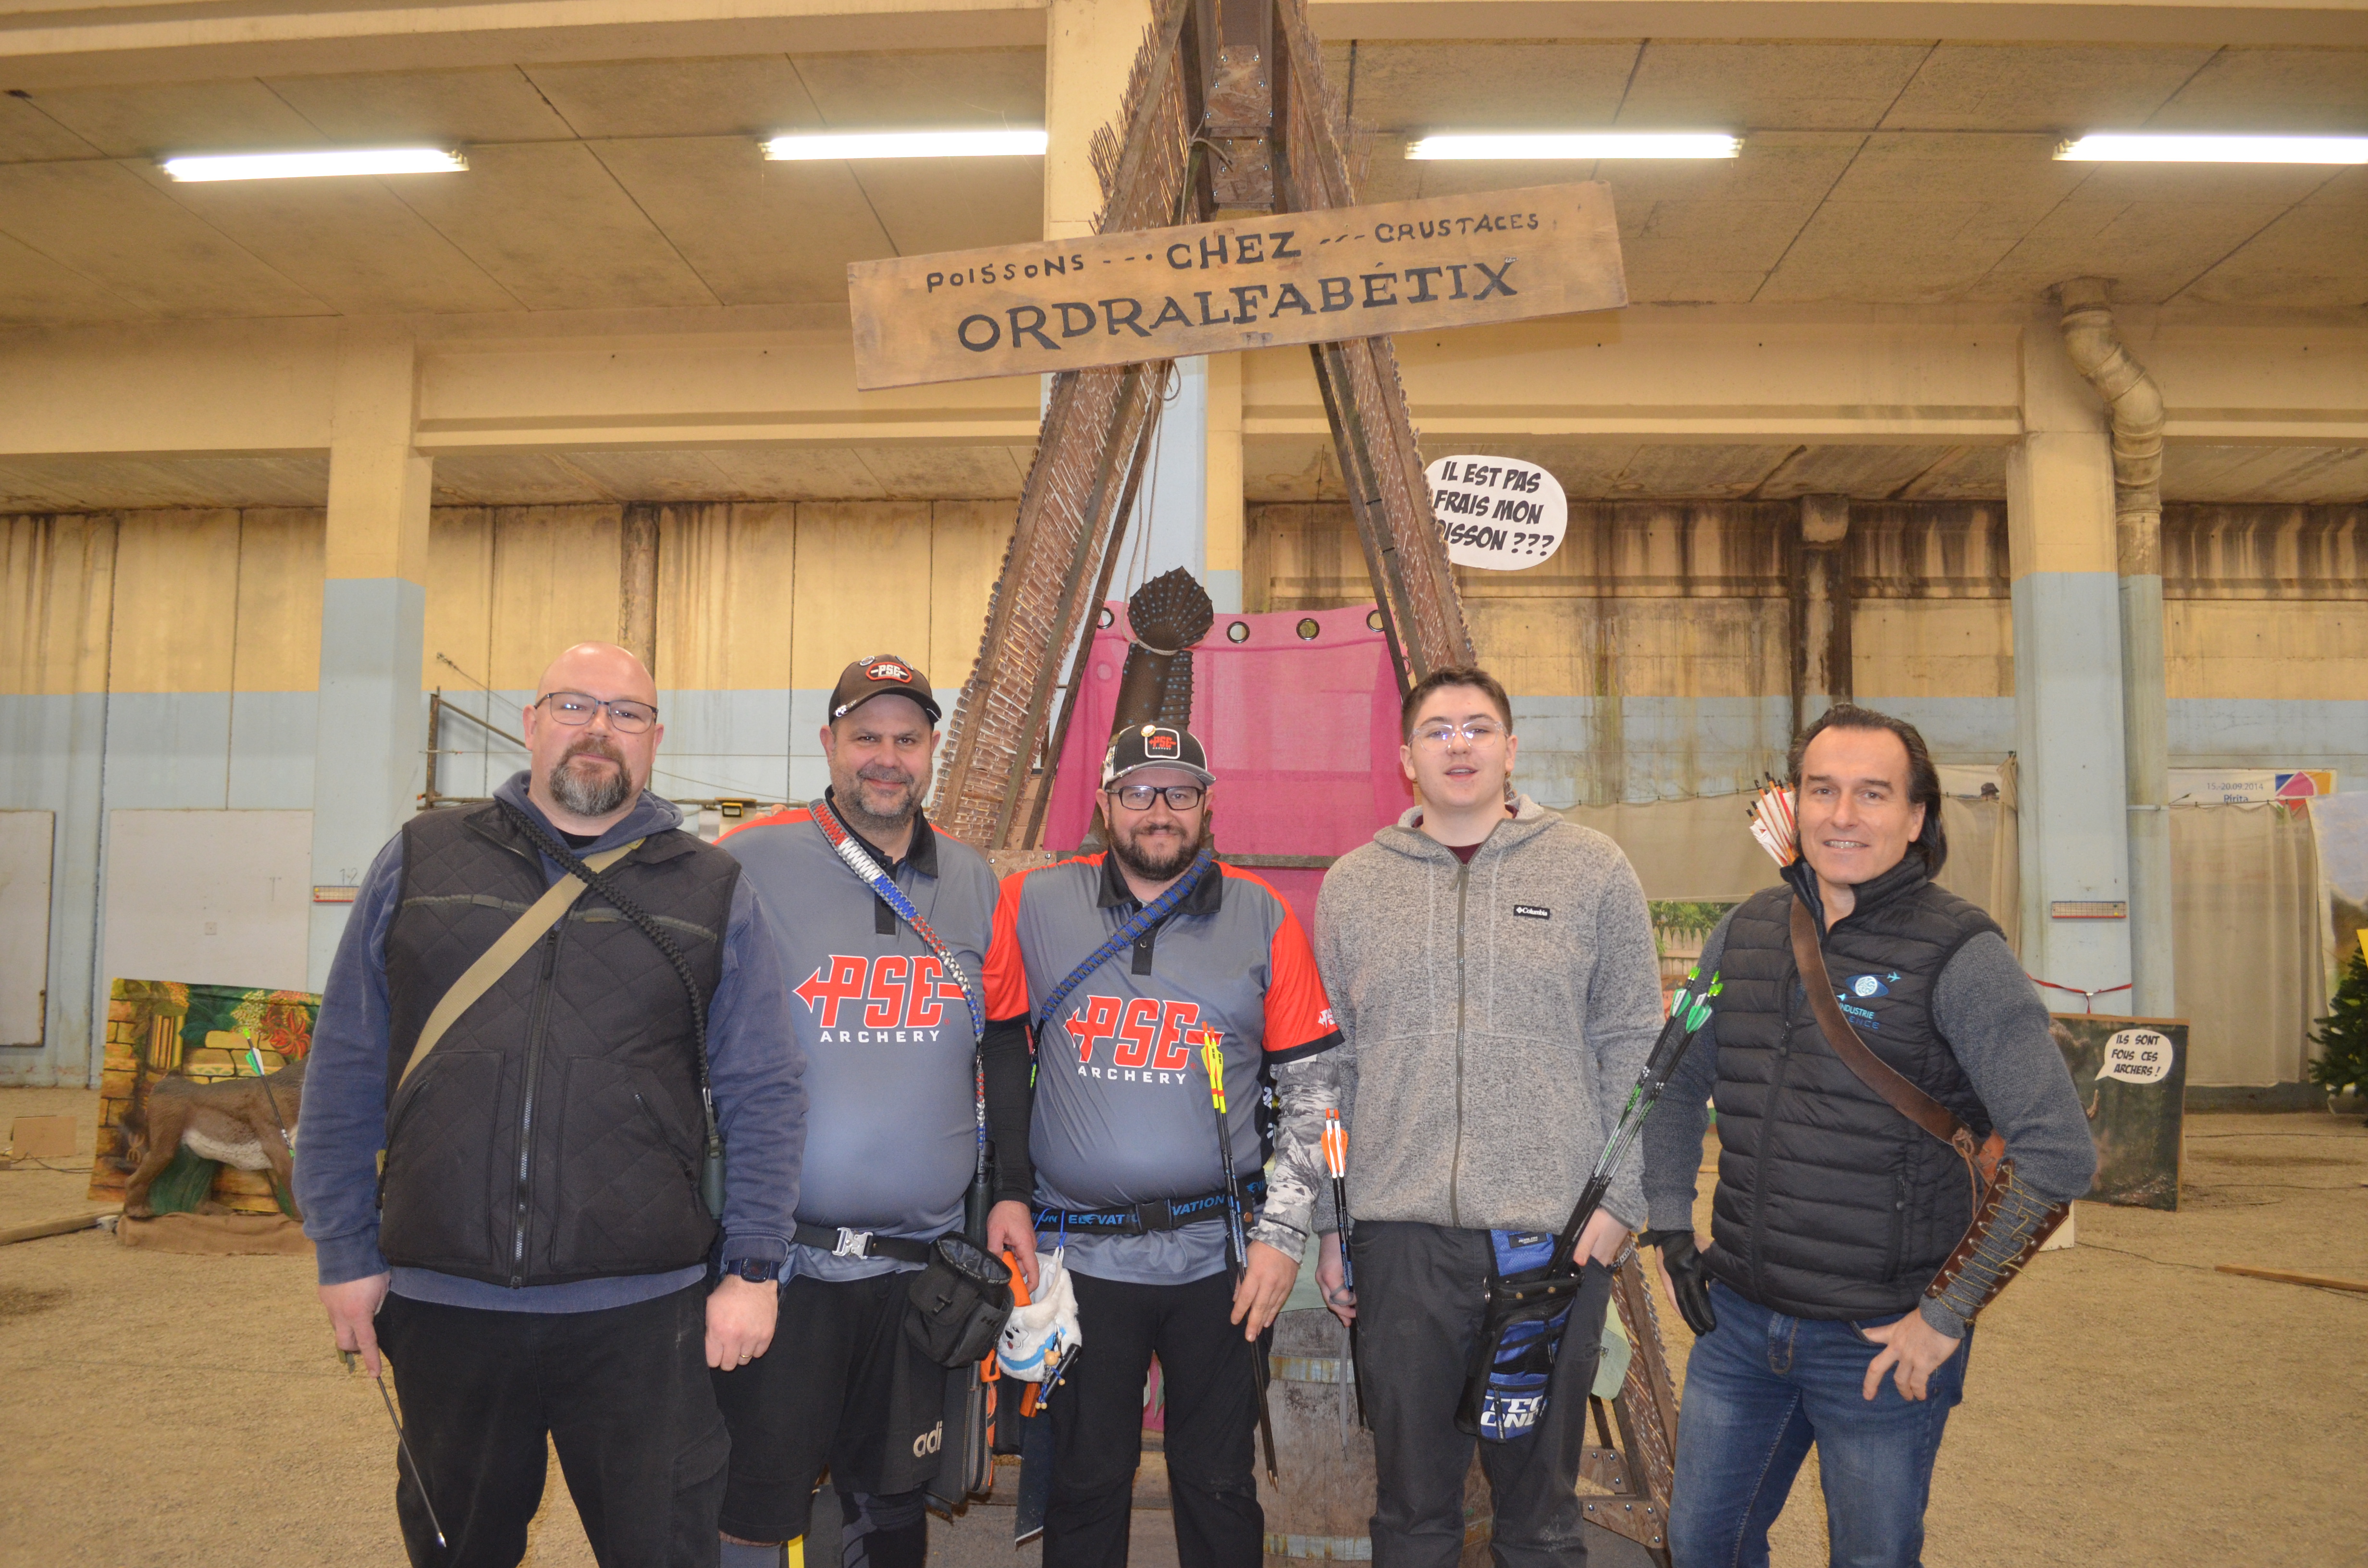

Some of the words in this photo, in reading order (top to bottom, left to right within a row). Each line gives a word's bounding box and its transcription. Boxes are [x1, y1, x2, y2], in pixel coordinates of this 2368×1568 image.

[927, 251, 1085, 293] POISSONS
[1166, 231, 1301, 270] CHEZ
[1375, 213, 1539, 243] CRUSTACES
[957, 257, 1519, 352] ORDRALFABÉTIX
[1442, 461, 1458, 481] IL
[1463, 463, 1503, 488] EST
[1502, 468, 1542, 494] PAS
[1433, 490, 1490, 516] FRAIS
[1492, 499, 1544, 525] MON
[1511, 532, 1555, 556] ???
[877, 664, 901, 676] PSE
[1153, 736, 1172, 748] PSE
[2207, 783, 2264, 791] 15.-20.09.2014
[1522, 907, 1548, 917] Columbia
[820, 955, 944, 1028] PSE
[1839, 1002, 1875, 1019] INDUSTRIE
[820, 1030, 941, 1043] ARCHERY
[1078, 994, 1200, 1070] PSE
[2116, 1034, 2129, 1044] ILS
[2135, 1034, 2160, 1045] SONT
[2111, 1048, 2134, 1060] FOUS
[2141, 1051, 2158, 1062] CES
[1077, 1065, 1187, 1084] ARCHERY
[2113, 1063, 2153, 1076] ARCHERS
